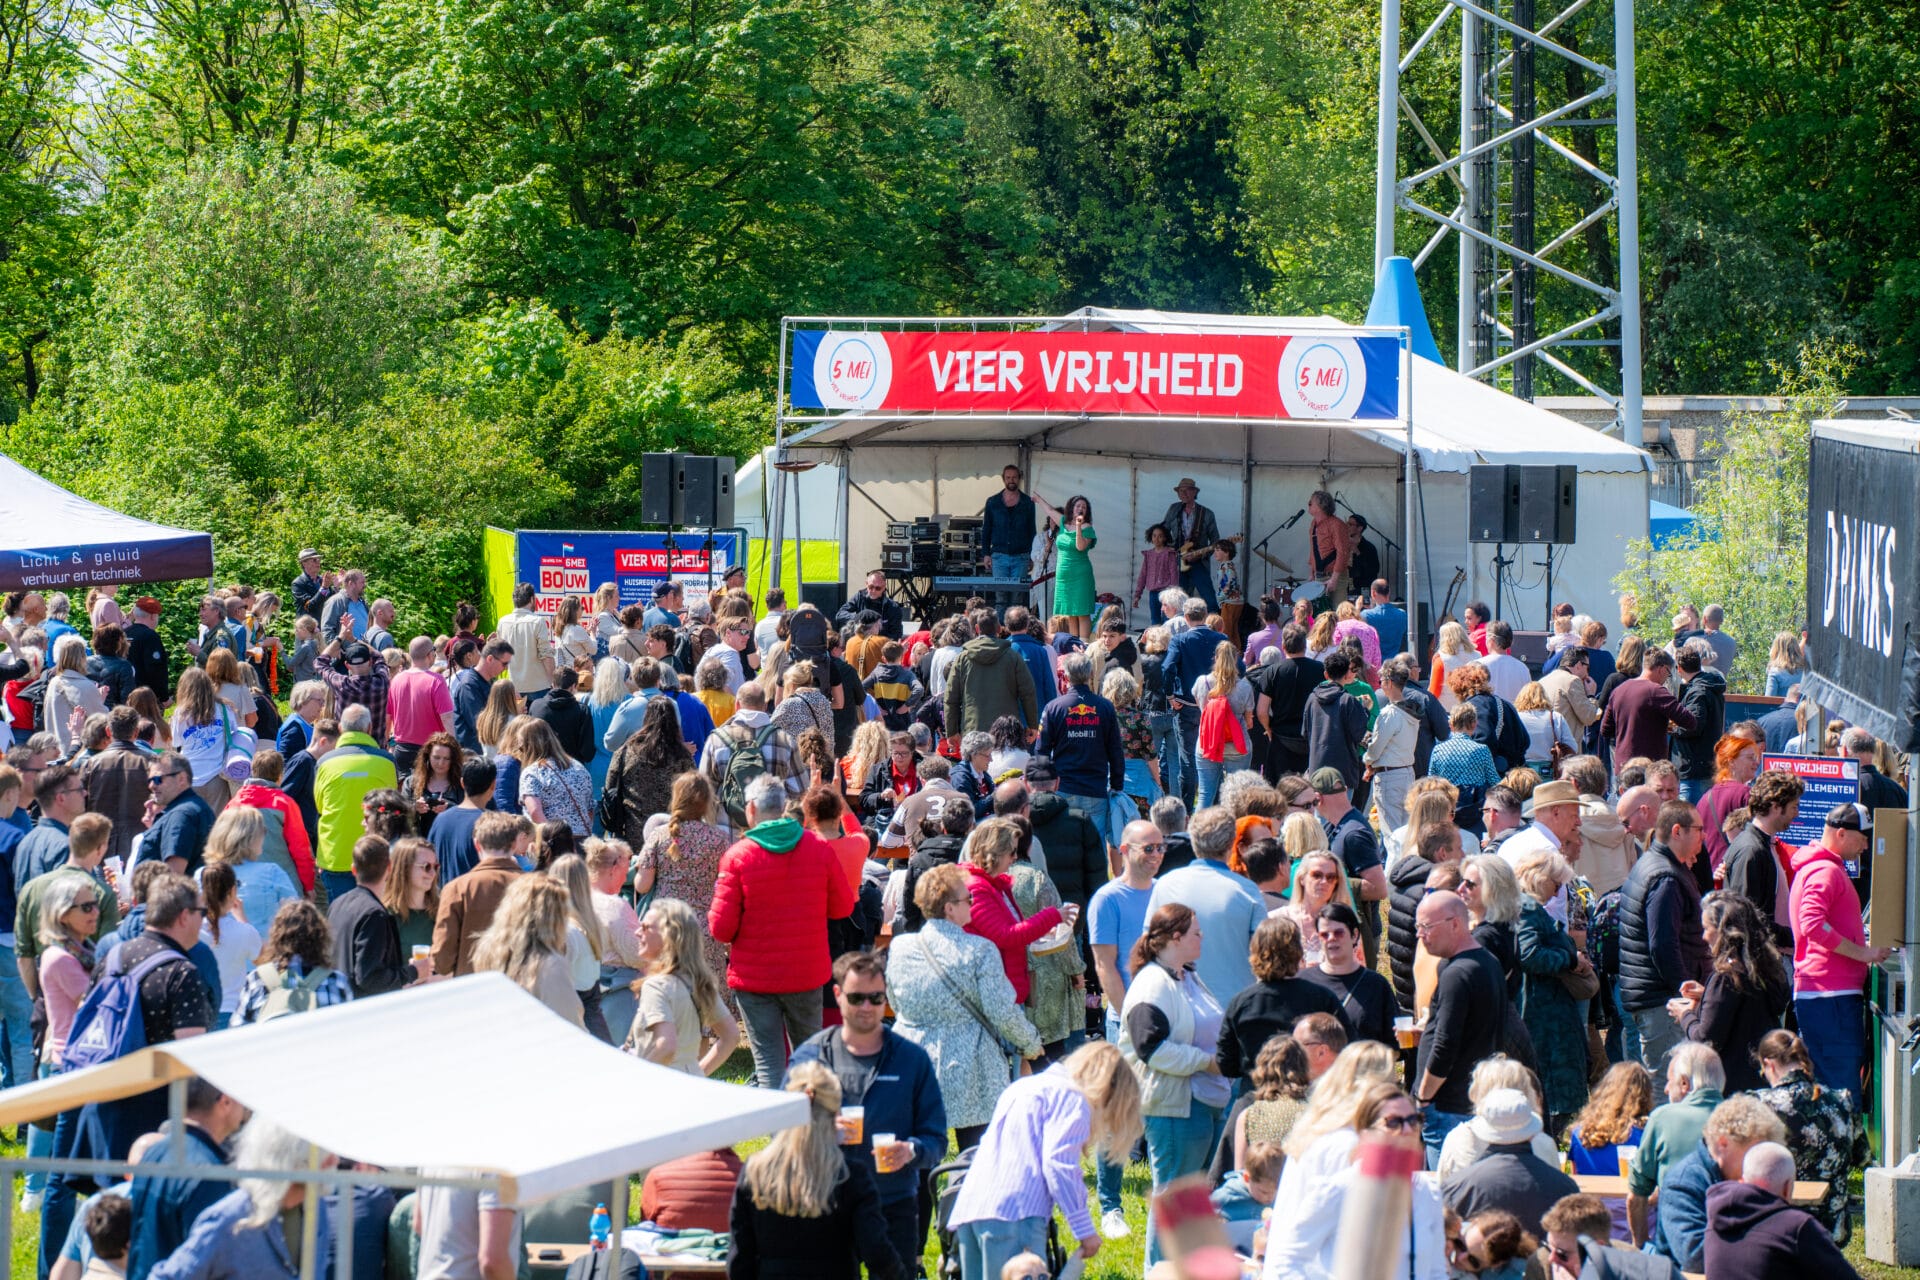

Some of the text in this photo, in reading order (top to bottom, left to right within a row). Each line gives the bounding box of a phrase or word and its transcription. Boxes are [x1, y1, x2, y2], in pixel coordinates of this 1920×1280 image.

[833, 360, 872, 379] 5 MEI
[929, 350, 1243, 397] VIER VRIJHEID
[1300, 367, 1343, 387] 5 MEI
[21, 548, 140, 568] Licht & geluid
[621, 553, 648, 567] VIER
[22, 565, 142, 585] verhuur en techniek
[541, 571, 587, 589] BOUW
[1823, 510, 1896, 658] DRINKS
[1066, 715, 1099, 727] Red Bull
[1067, 730, 1088, 738] Mobil
[1769, 761, 1791, 773] VIER
[1793, 763, 1839, 775] VRIJHEID
[925, 795, 946, 820] 3
